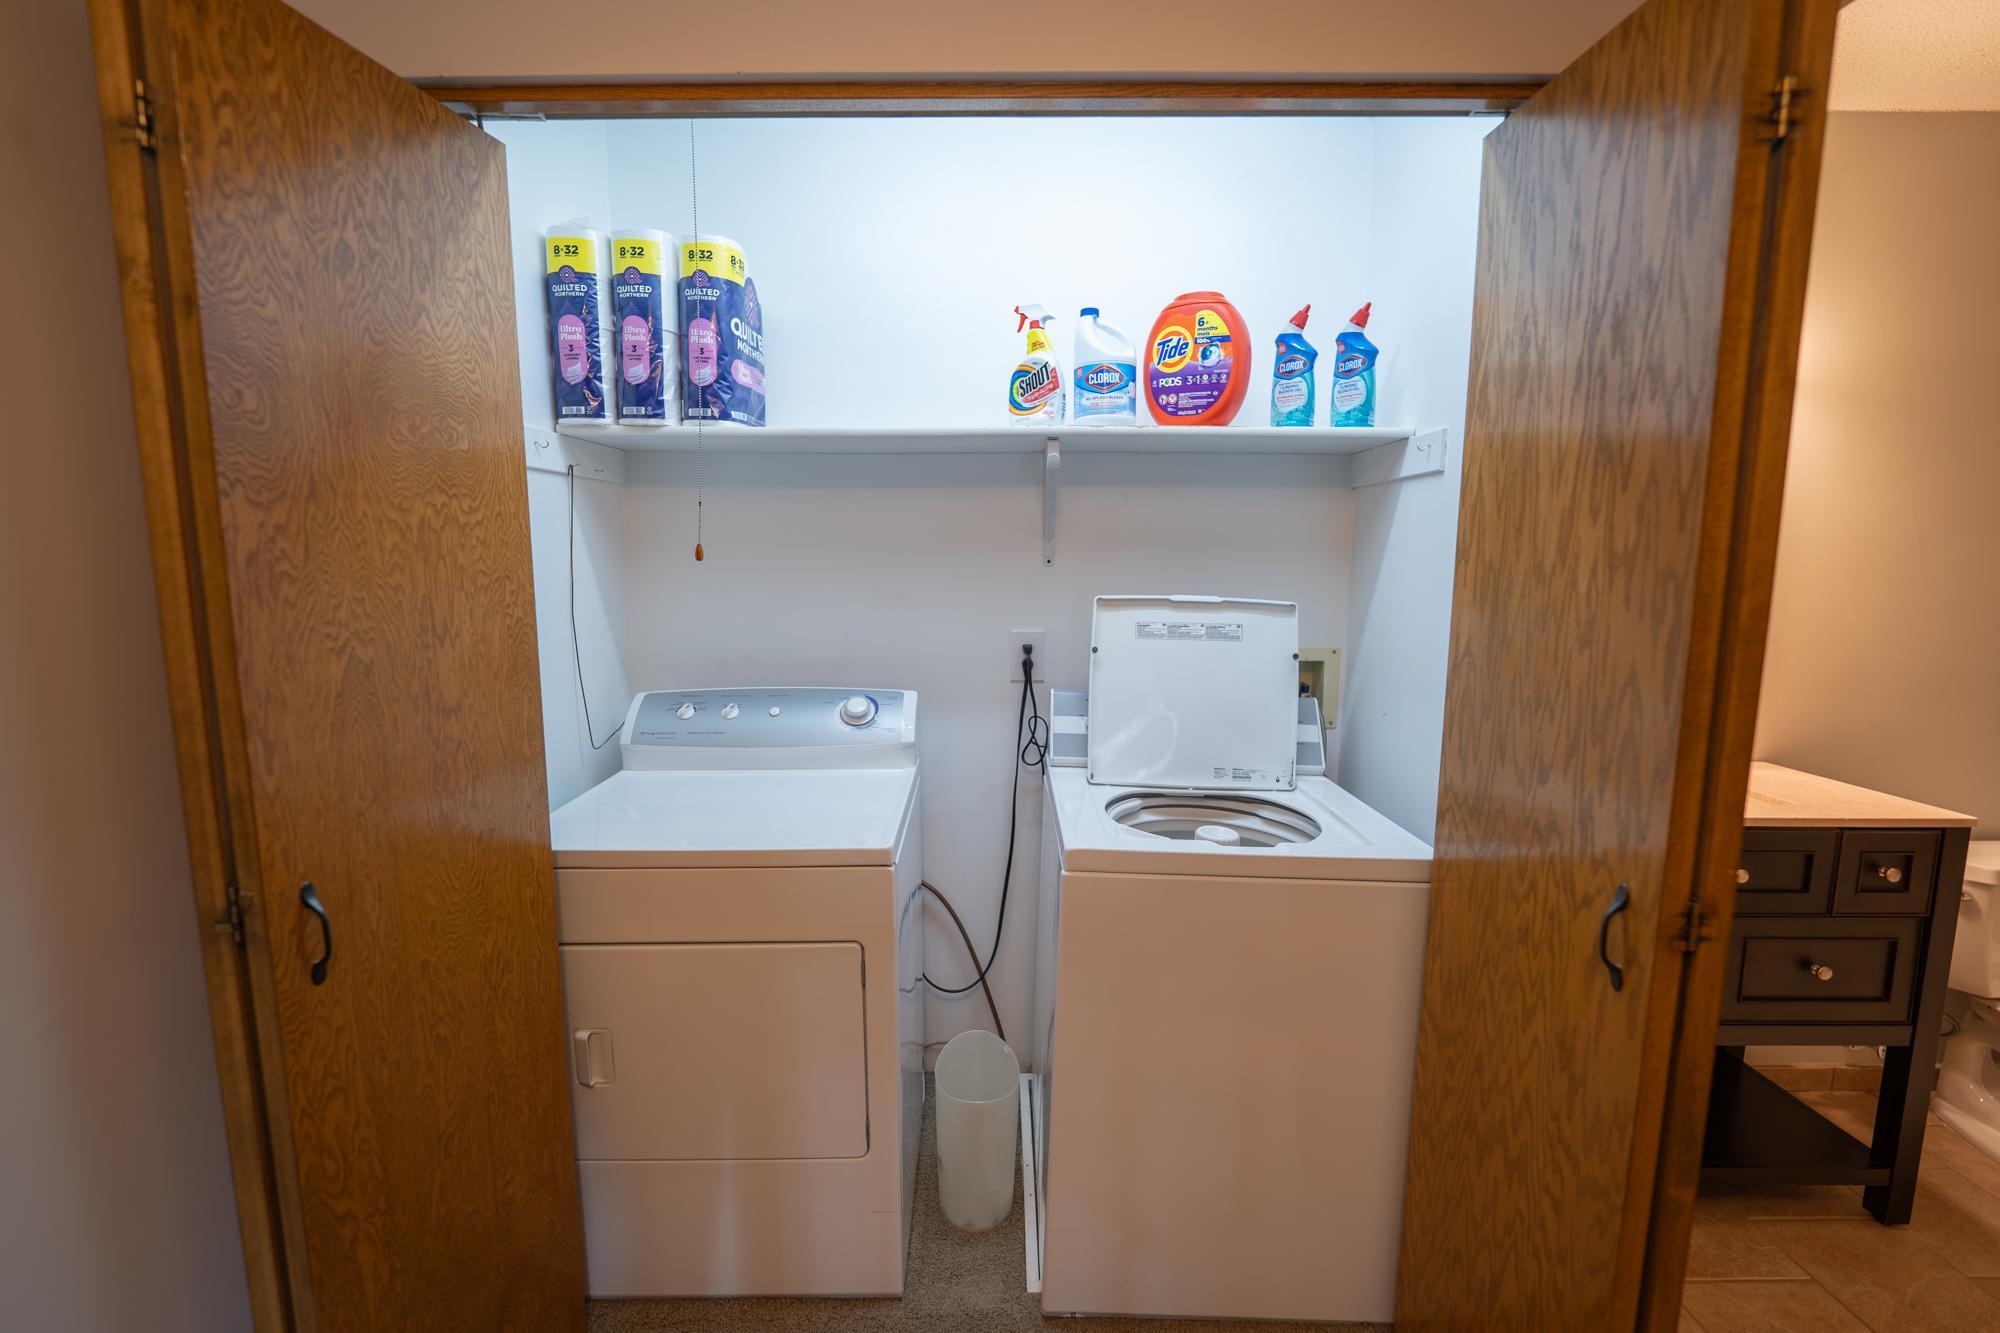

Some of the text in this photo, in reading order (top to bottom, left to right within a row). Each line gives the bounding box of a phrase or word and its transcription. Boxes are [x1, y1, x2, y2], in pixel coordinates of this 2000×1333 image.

[552, 284, 588, 292] QUILTED
[617, 285, 653, 293] QUILTED
[685, 288, 720, 297] QUILTED
[560, 325, 582, 333] Ultra
[624, 326, 646, 334] Ultra
[560, 332, 583, 341] Plush
[624, 333, 647, 342] Plush
[730, 317, 764, 353] QUILTE
[568, 344, 574, 352] 3
[631, 345, 637, 353] 3
[1156, 336, 1190, 367] Tide
[1279, 360, 1304, 373] CLOROX
[1338, 359, 1363, 372] CLOROX
[1018, 361, 1051, 398] SHOUT
[1088, 372, 1121, 385] CLOROX
[1159, 376, 1182, 388] PODS
